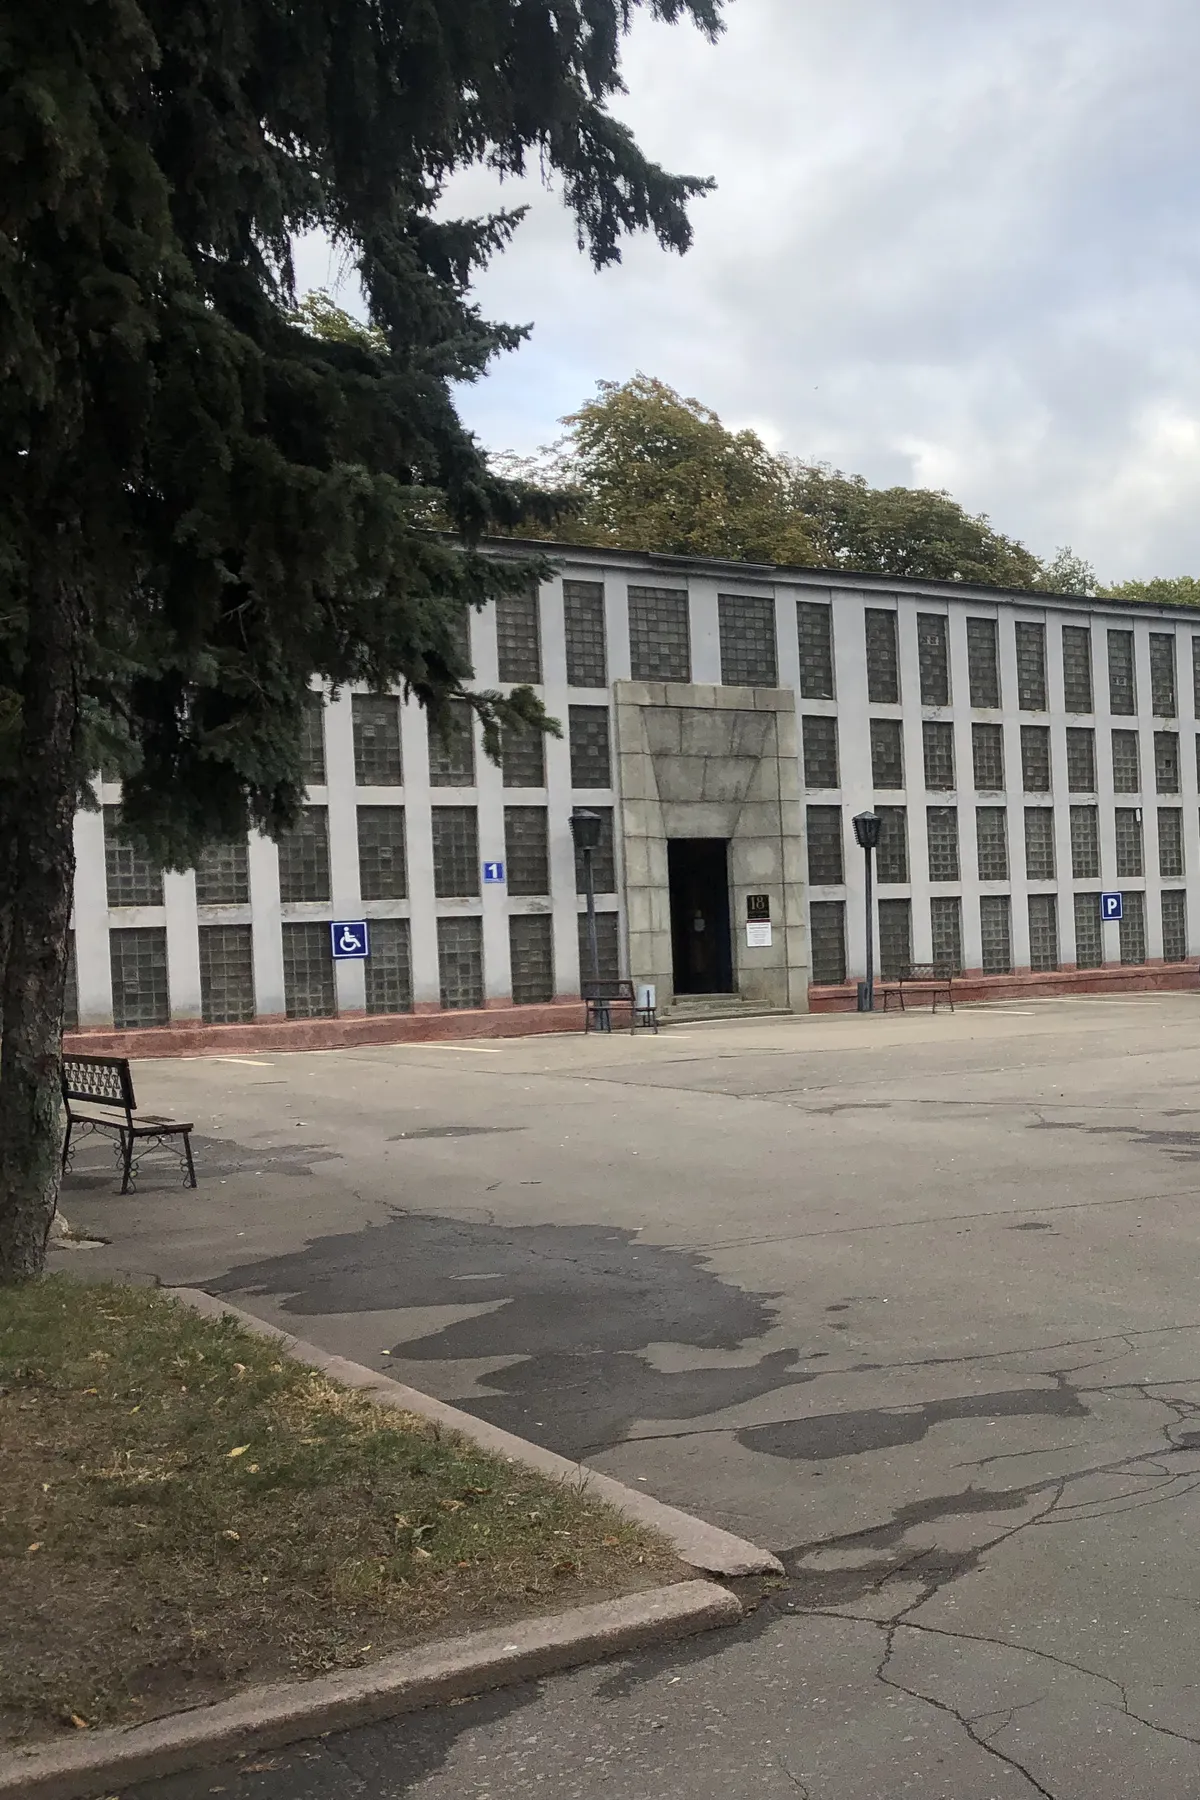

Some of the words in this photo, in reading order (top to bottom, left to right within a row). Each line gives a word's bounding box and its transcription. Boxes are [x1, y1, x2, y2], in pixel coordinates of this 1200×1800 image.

[489, 864, 498, 878] 1
[751, 896, 765, 910] 18
[1107, 898, 1118, 915] P
